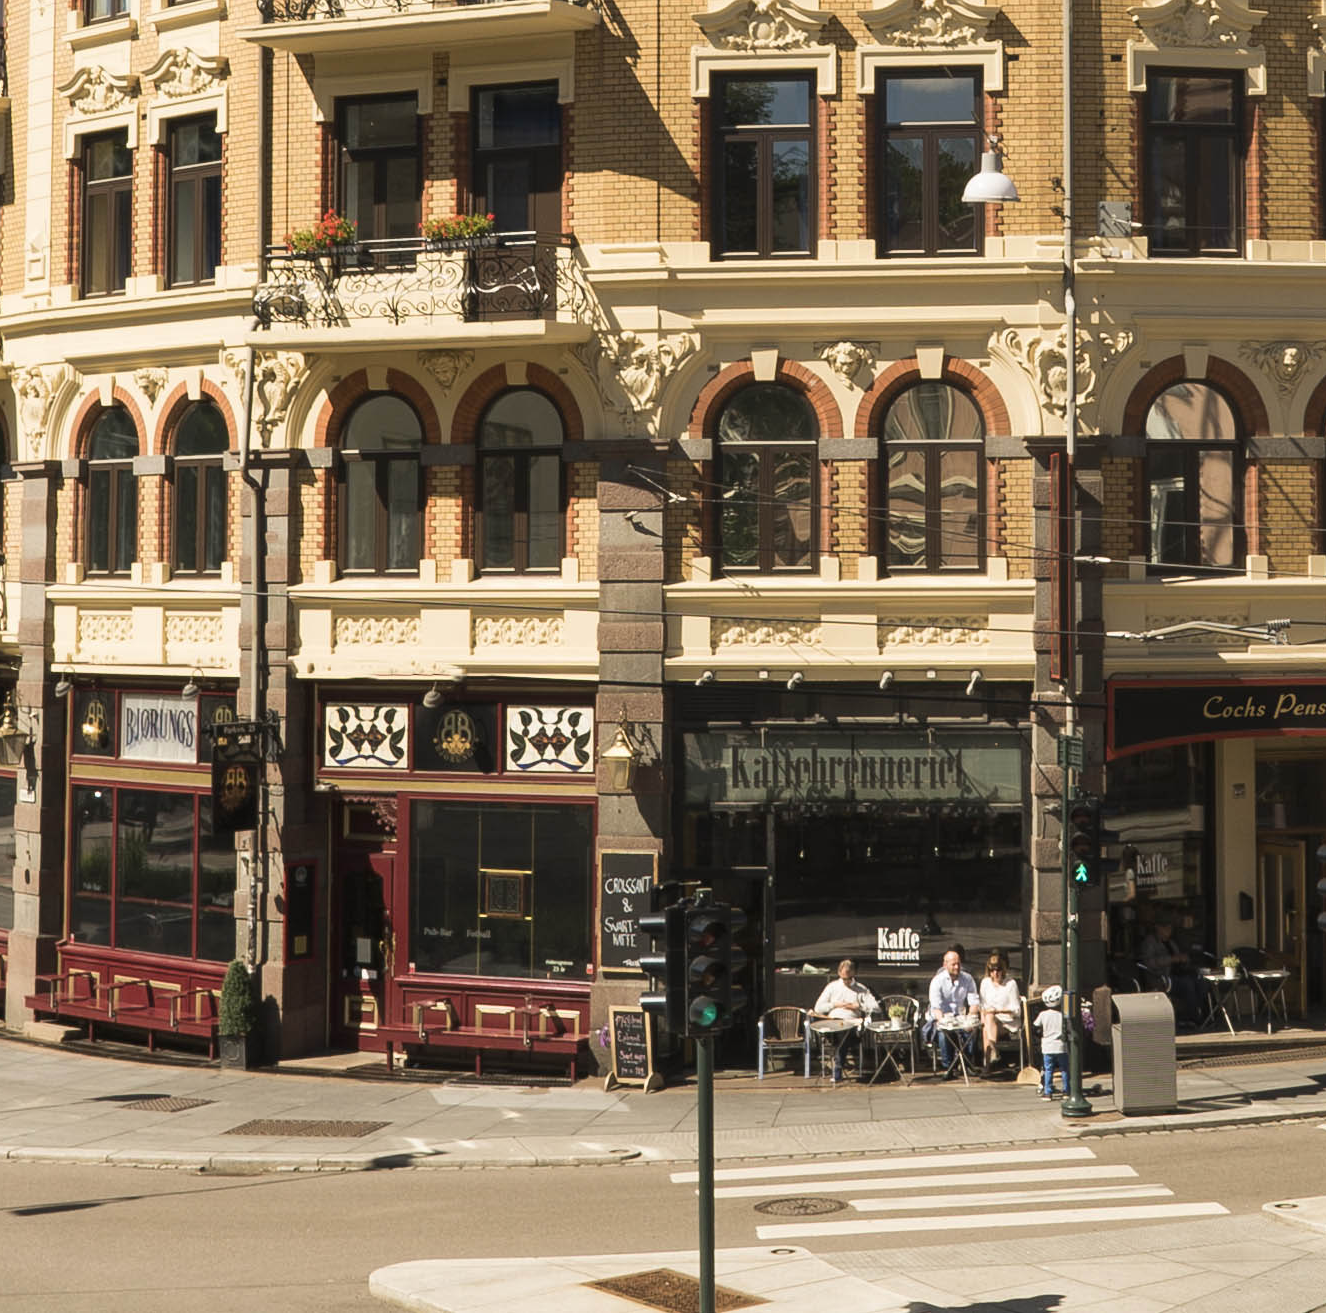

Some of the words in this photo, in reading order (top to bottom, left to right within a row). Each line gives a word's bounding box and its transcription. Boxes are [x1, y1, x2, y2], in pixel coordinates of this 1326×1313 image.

[1203, 696, 1266, 719] Cochs
[1137, 853, 1168, 874] Kaffe
[622, 897, 633, 913] &
[877, 927, 920, 949] Kaffe
[877, 949, 920, 961] brenneriet
